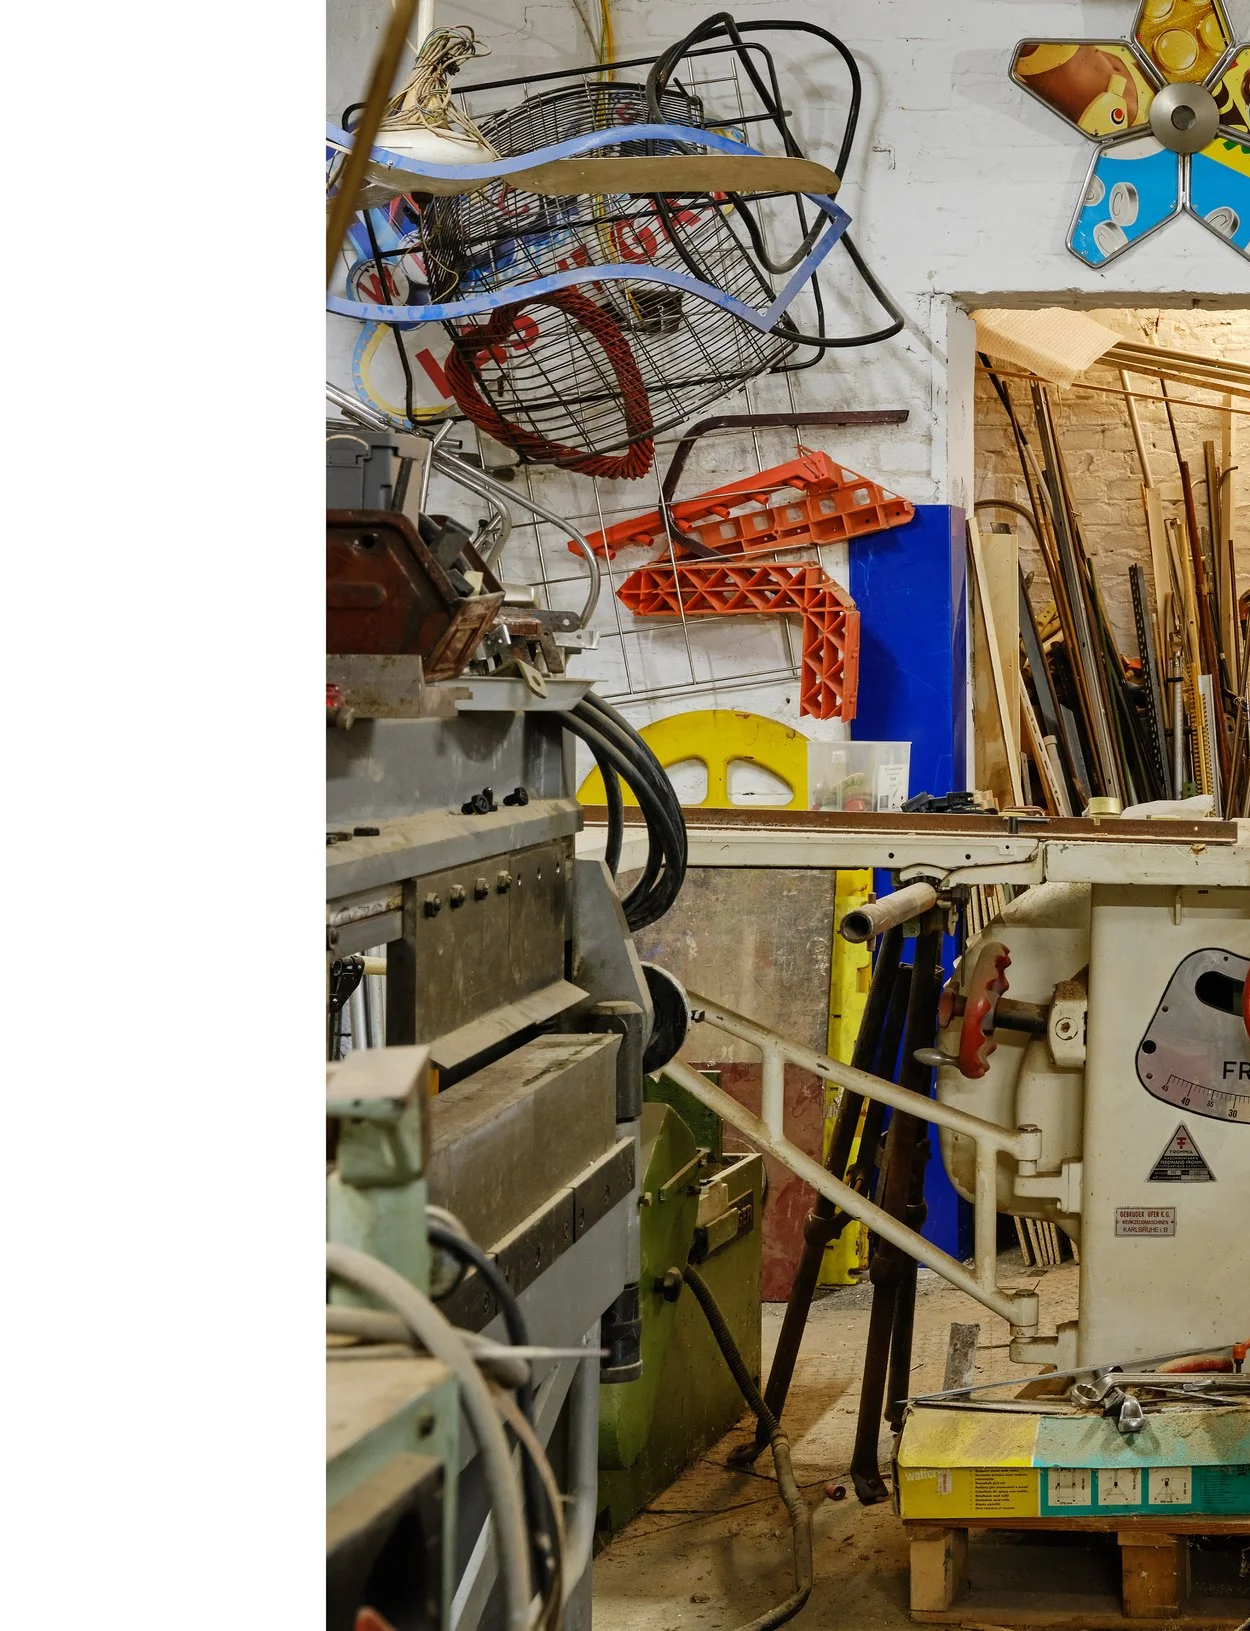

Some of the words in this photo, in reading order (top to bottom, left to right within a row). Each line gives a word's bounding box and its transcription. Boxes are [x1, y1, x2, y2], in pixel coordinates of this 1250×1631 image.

[1161, 1084, 1169, 1092] 45
[1180, 1096, 1191, 1107] 40
[1206, 1100, 1214, 1108] 35
[1228, 1109, 1238, 1118] 30
